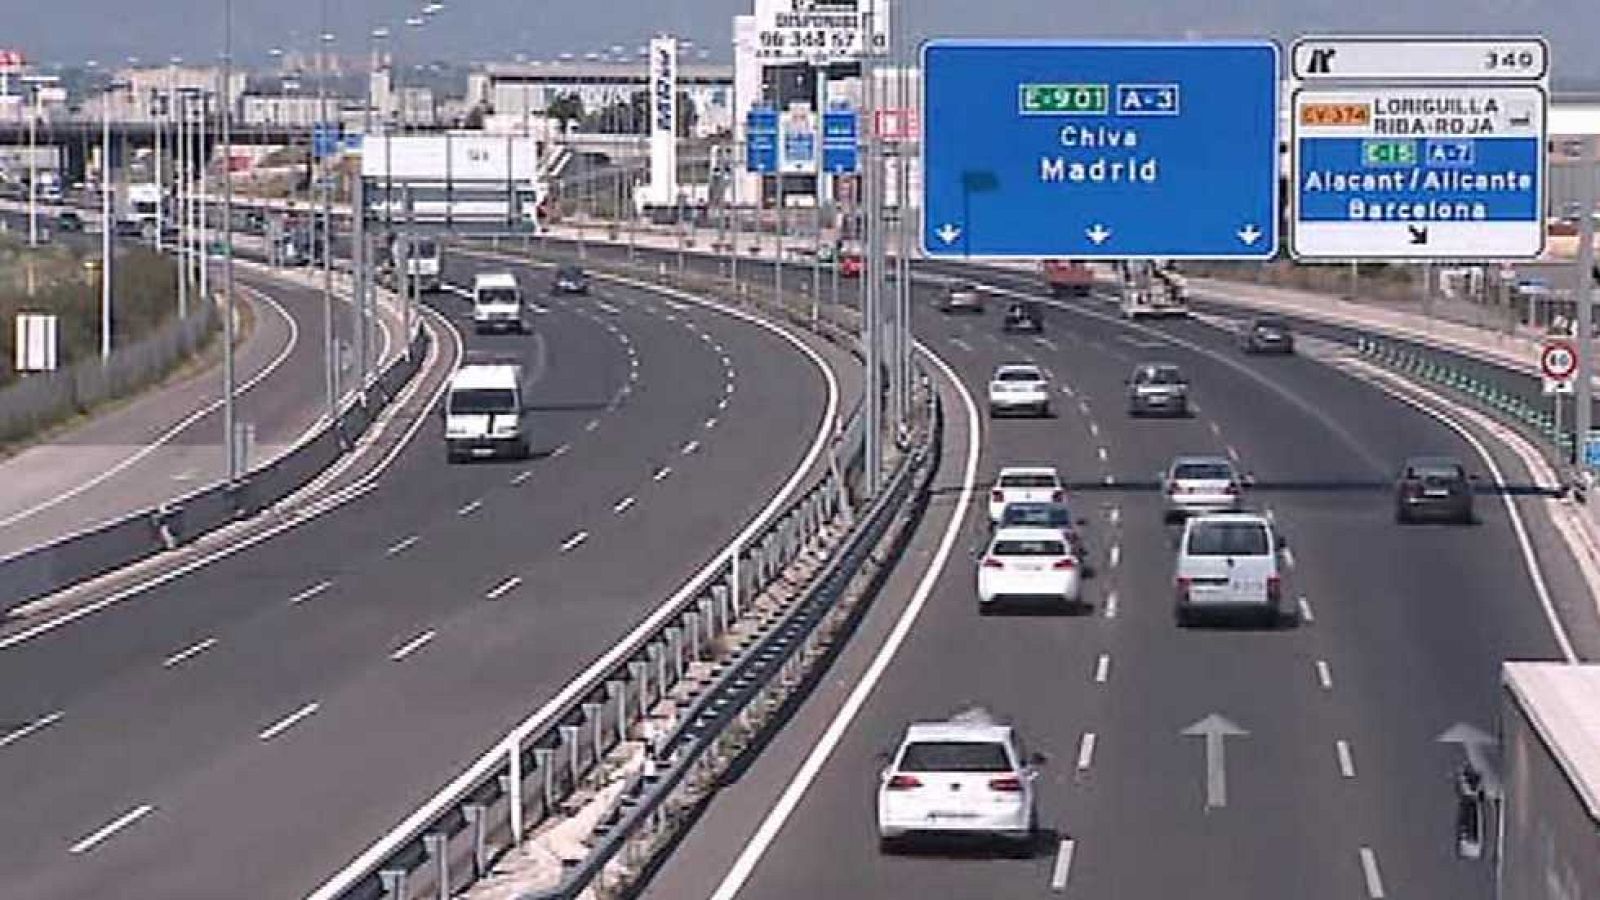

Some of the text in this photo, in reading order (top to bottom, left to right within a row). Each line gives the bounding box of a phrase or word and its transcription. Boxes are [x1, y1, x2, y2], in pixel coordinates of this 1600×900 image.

[1123, 89, 1173, 108] A-3
[1060, 126, 1138, 147] Chiva
[1041, 156, 1158, 183] Madrid
[1348, 198, 1487, 219] Barcelona
